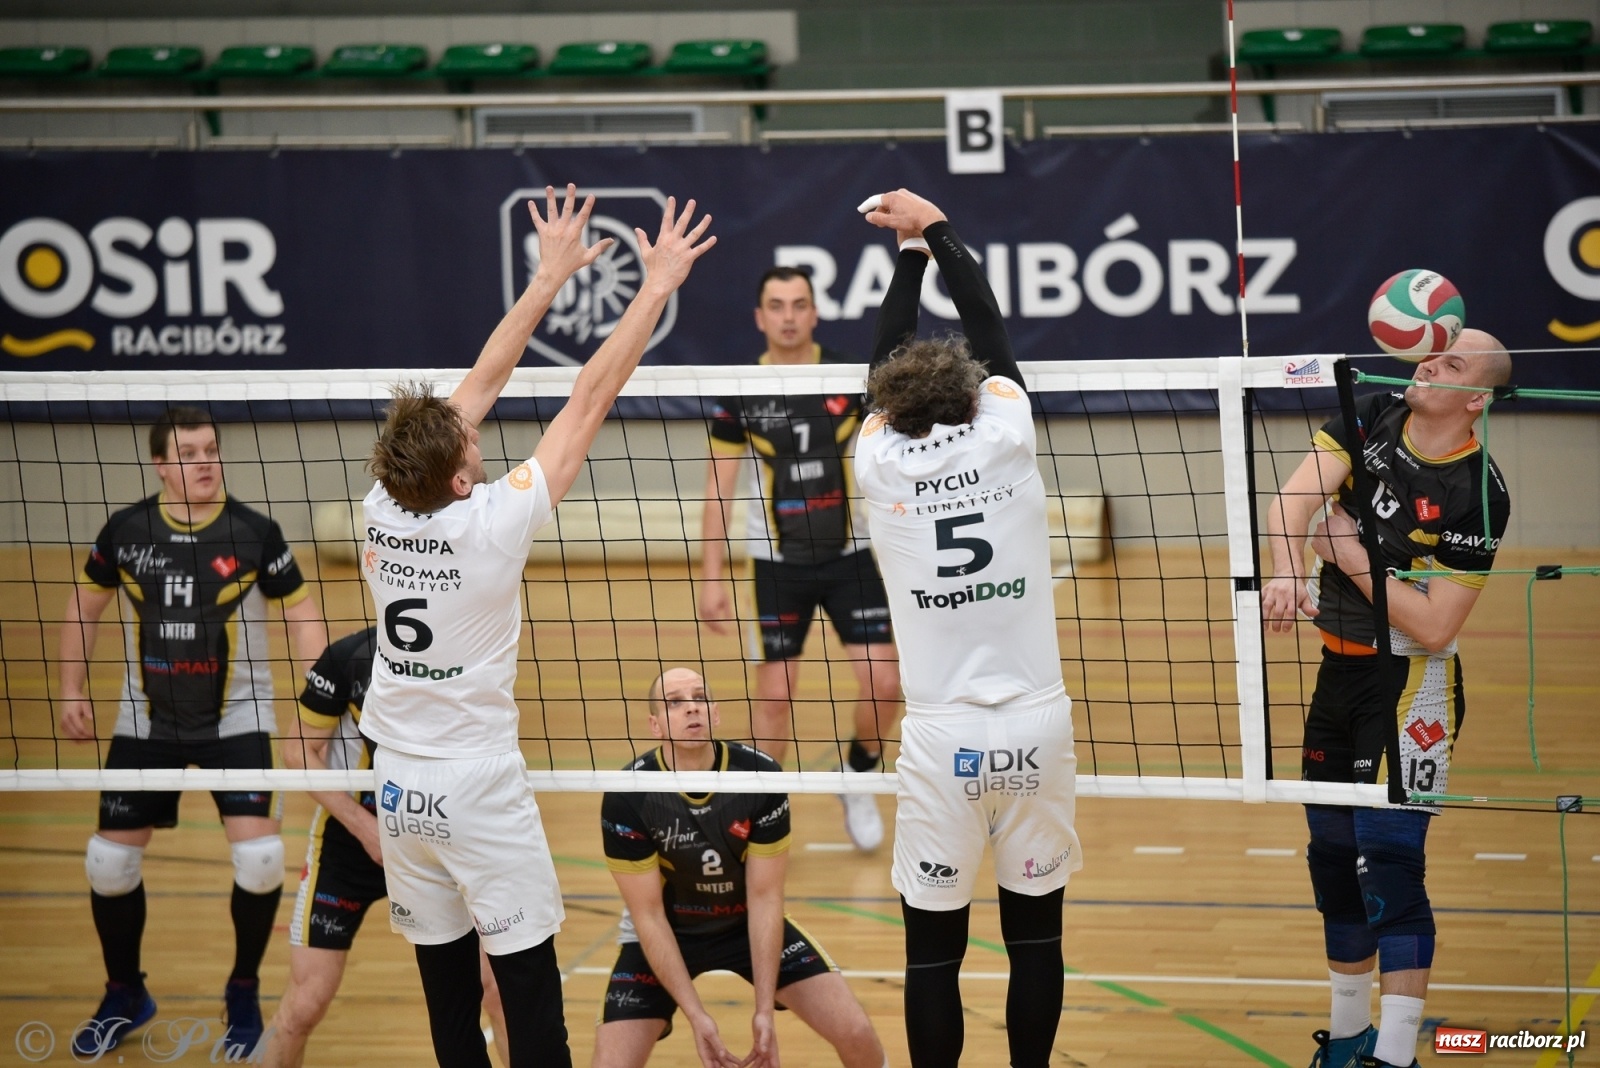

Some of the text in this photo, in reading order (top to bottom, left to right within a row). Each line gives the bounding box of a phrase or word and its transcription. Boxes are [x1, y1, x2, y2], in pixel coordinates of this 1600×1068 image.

[957, 108, 994, 153] B
[112, 317, 287, 356] RACIBÓRZ
[915, 468, 980, 497] PYCIU
[916, 487, 1014, 516] LUNATYCY
[1371, 480, 1401, 520] 13
[1421, 499, 1430, 518] Enter
[367, 526, 455, 556] SKORUPA
[934, 512, 994, 578] 5
[165, 575, 194, 607] 14
[379, 572, 462, 592] LUNATYCY
[911, 576, 1026, 610] TropiDog
[384, 597, 434, 653] 6
[1415, 722, 1433, 744] Enter
[988, 746, 1040, 773] DK
[1408, 757, 1437, 792] 13
[964, 771, 1040, 801] glass
[406, 789, 449, 820] DK
[385, 809, 451, 839] glass
[701, 848, 724, 875] 2
[695, 881, 735, 894] ENTER
[916, 873, 958, 885] wepol
